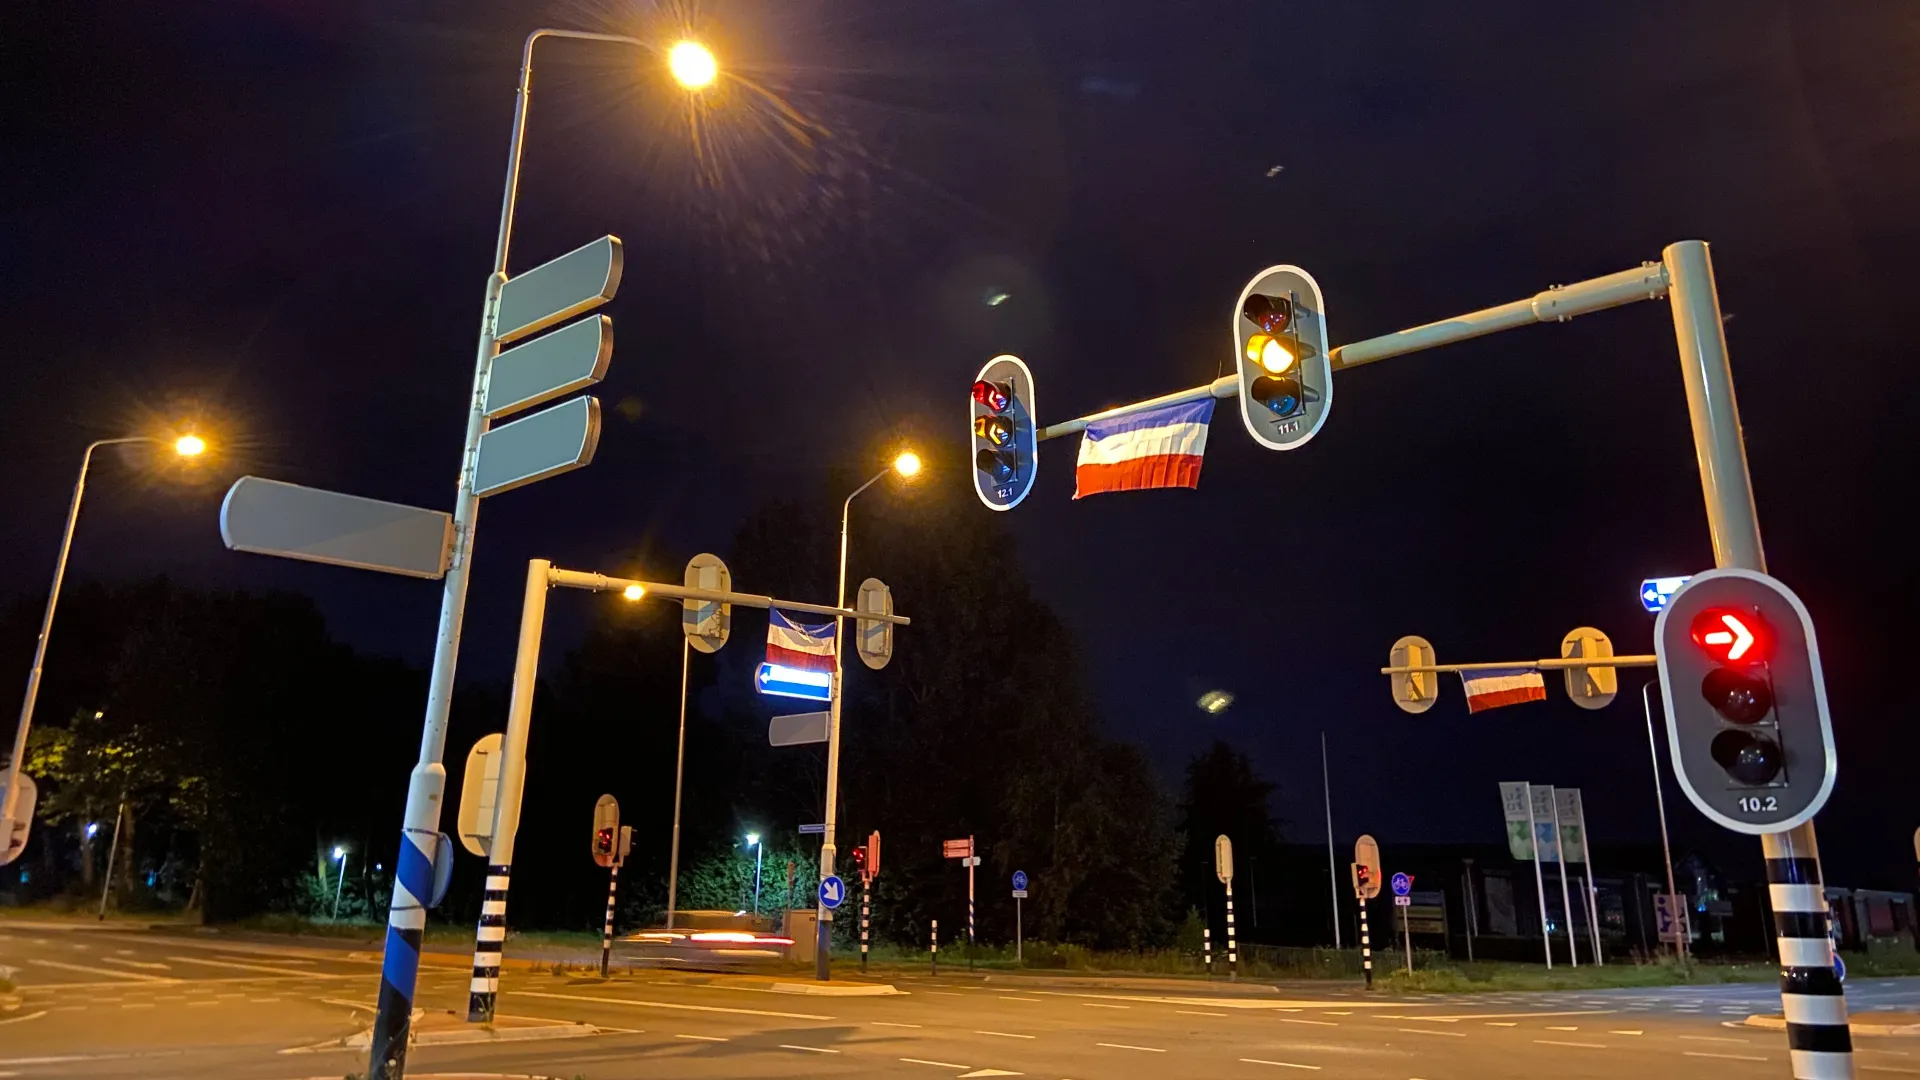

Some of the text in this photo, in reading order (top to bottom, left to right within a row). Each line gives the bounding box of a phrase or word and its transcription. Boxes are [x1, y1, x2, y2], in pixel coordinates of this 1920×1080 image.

[1278, 420, 1299, 435] 11.1
[997, 487, 1013, 499] 12.1
[1739, 796, 1778, 812] 10.2
